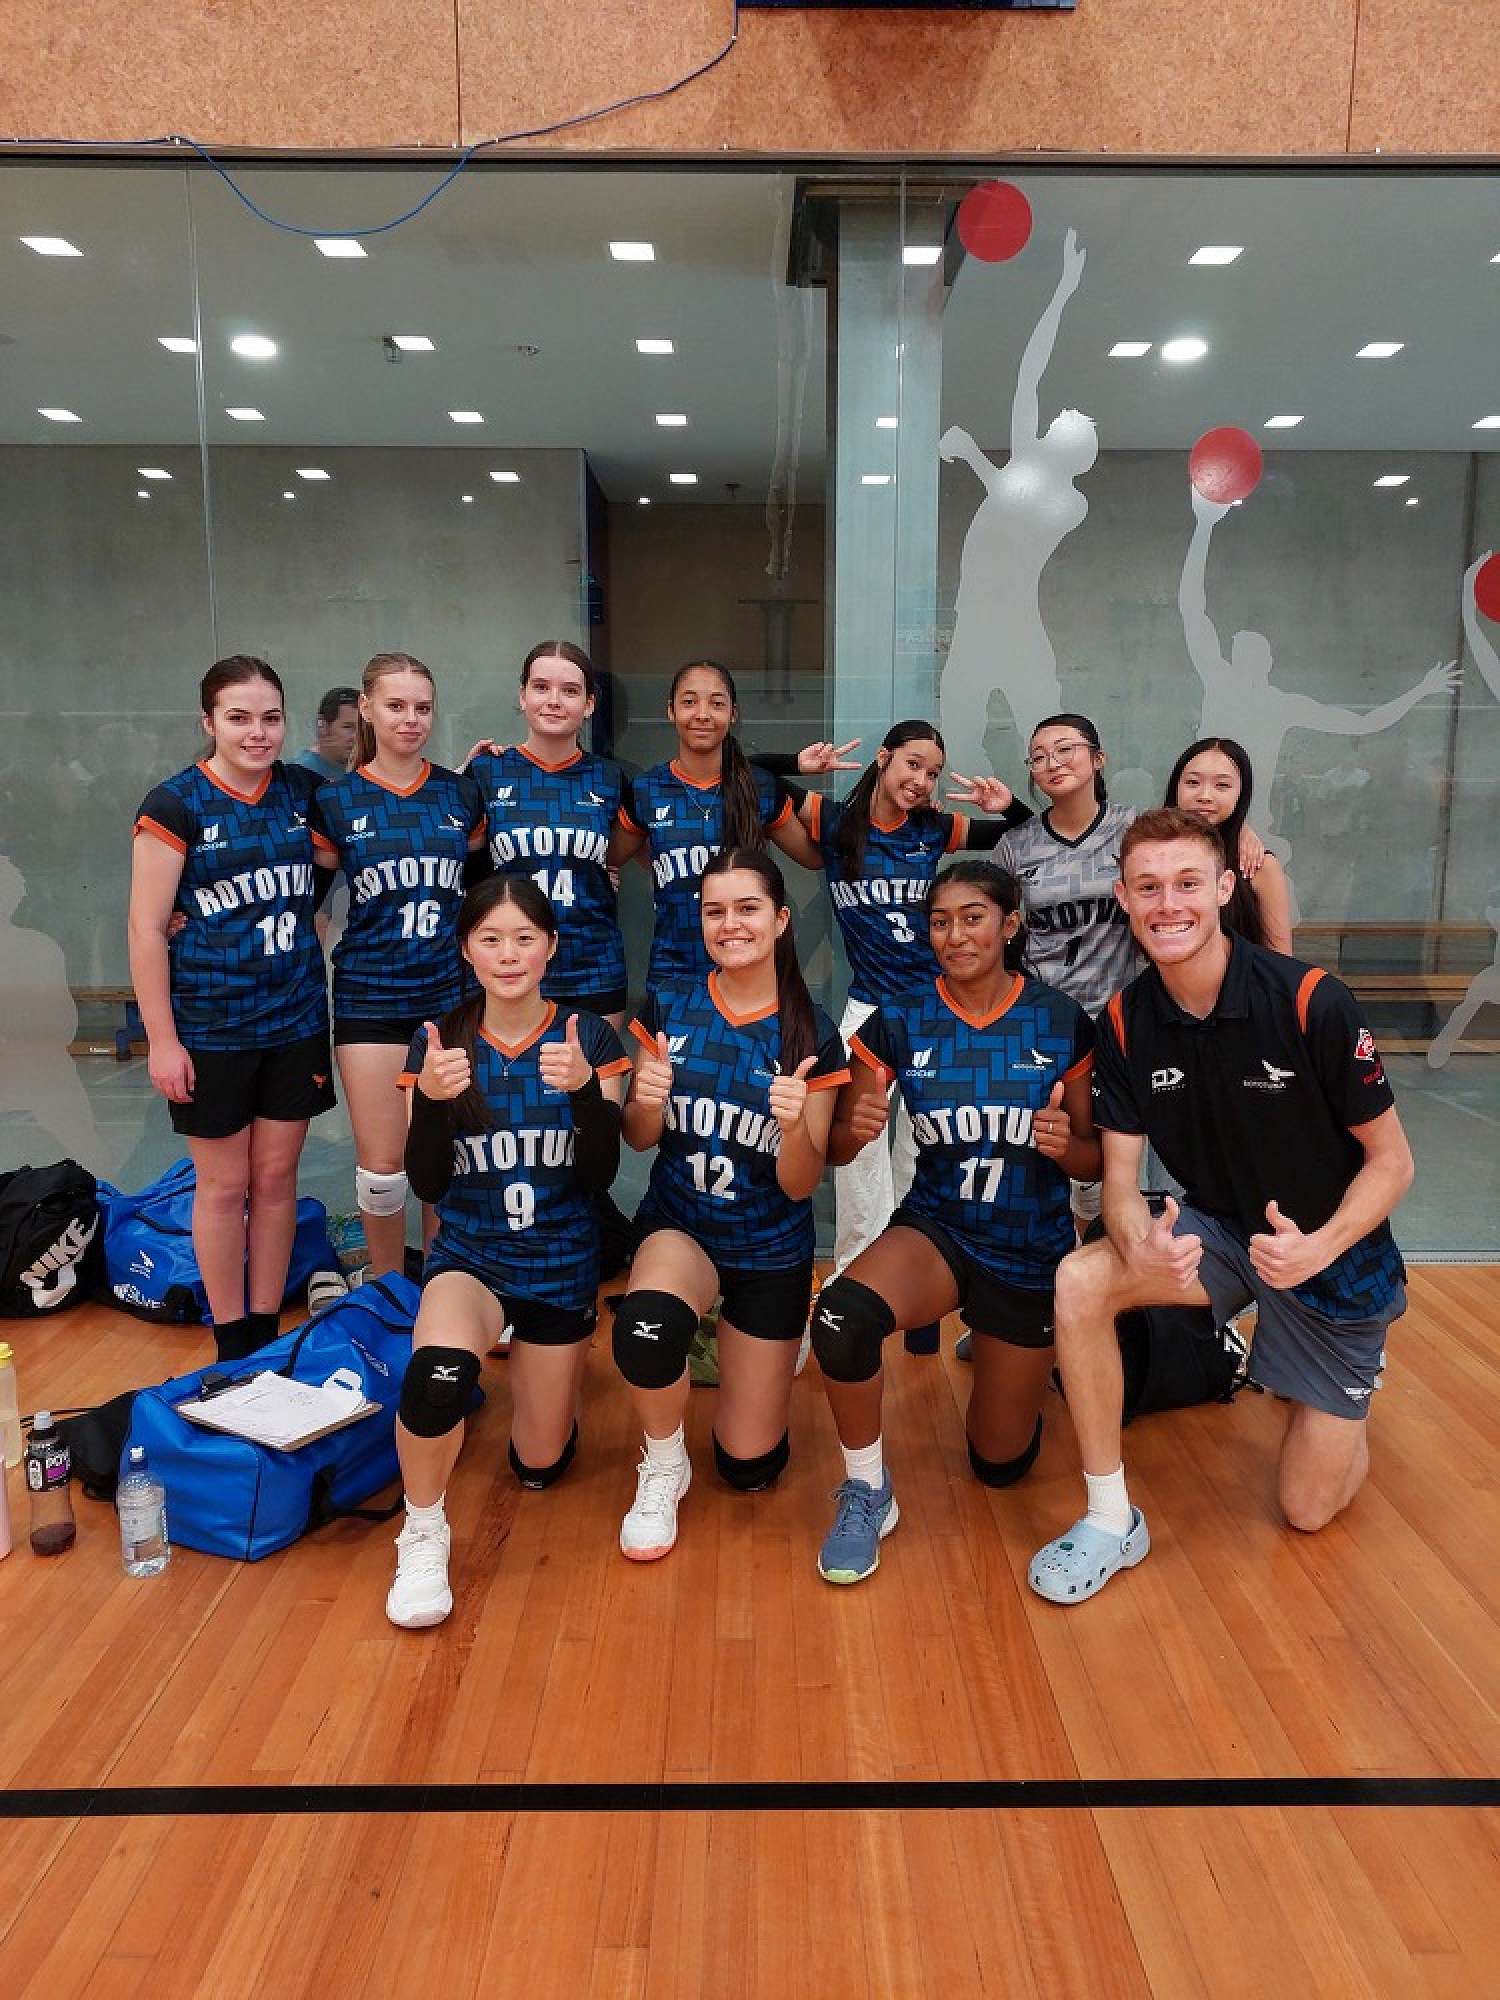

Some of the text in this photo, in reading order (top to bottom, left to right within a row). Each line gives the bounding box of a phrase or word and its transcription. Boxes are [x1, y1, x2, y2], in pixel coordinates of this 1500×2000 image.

[532, 869, 577, 907] 14
[256, 911, 297, 956] 18
[398, 899, 441, 939] 16
[886, 912, 916, 942] 3
[686, 1151, 736, 1201] 12
[959, 1157, 1005, 1203] 17
[503, 1182, 536, 1231] 9
[20, 1217, 87, 1288] NIKE
